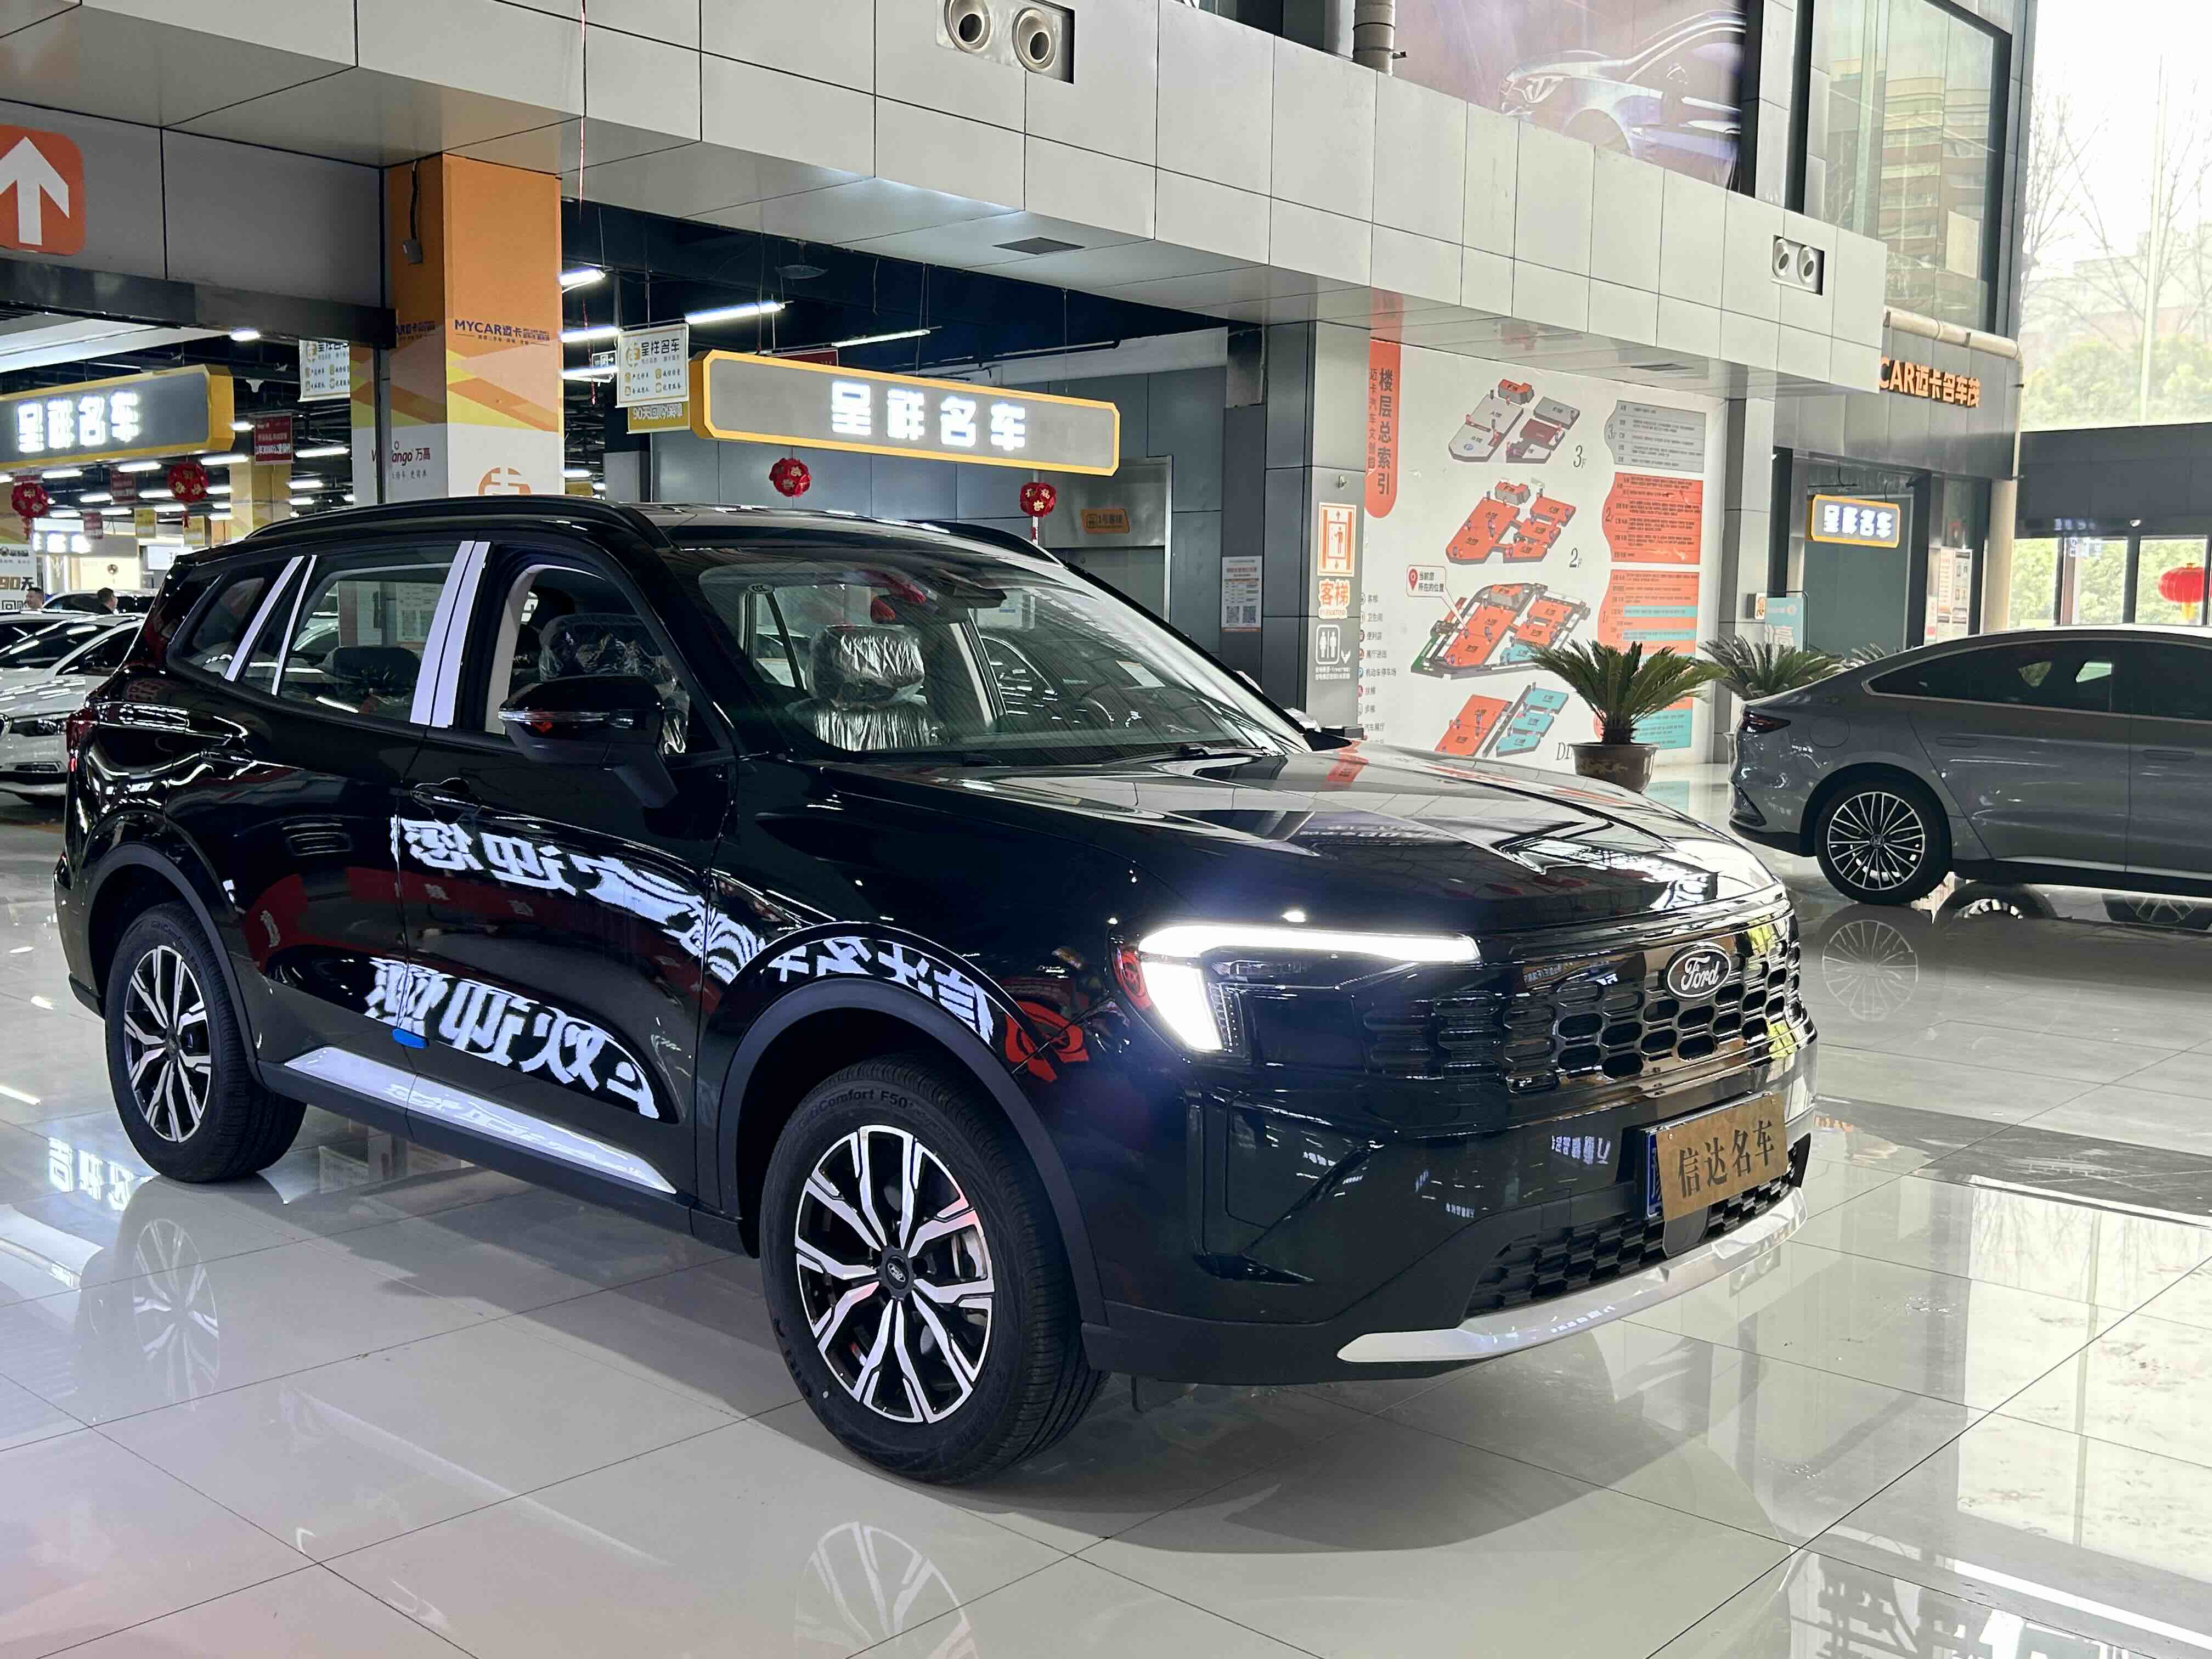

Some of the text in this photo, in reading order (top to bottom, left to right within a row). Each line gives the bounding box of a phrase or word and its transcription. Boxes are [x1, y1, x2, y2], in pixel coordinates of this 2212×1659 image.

[832, 381, 1026, 451] 呈祥名车
[1378, 368, 1392, 495] 楼层总索引
[1319, 580, 1349, 606] 客梯
[1680, 956, 1719, 990] Ford
[1678, 1119, 1775, 1199] 信达名车
